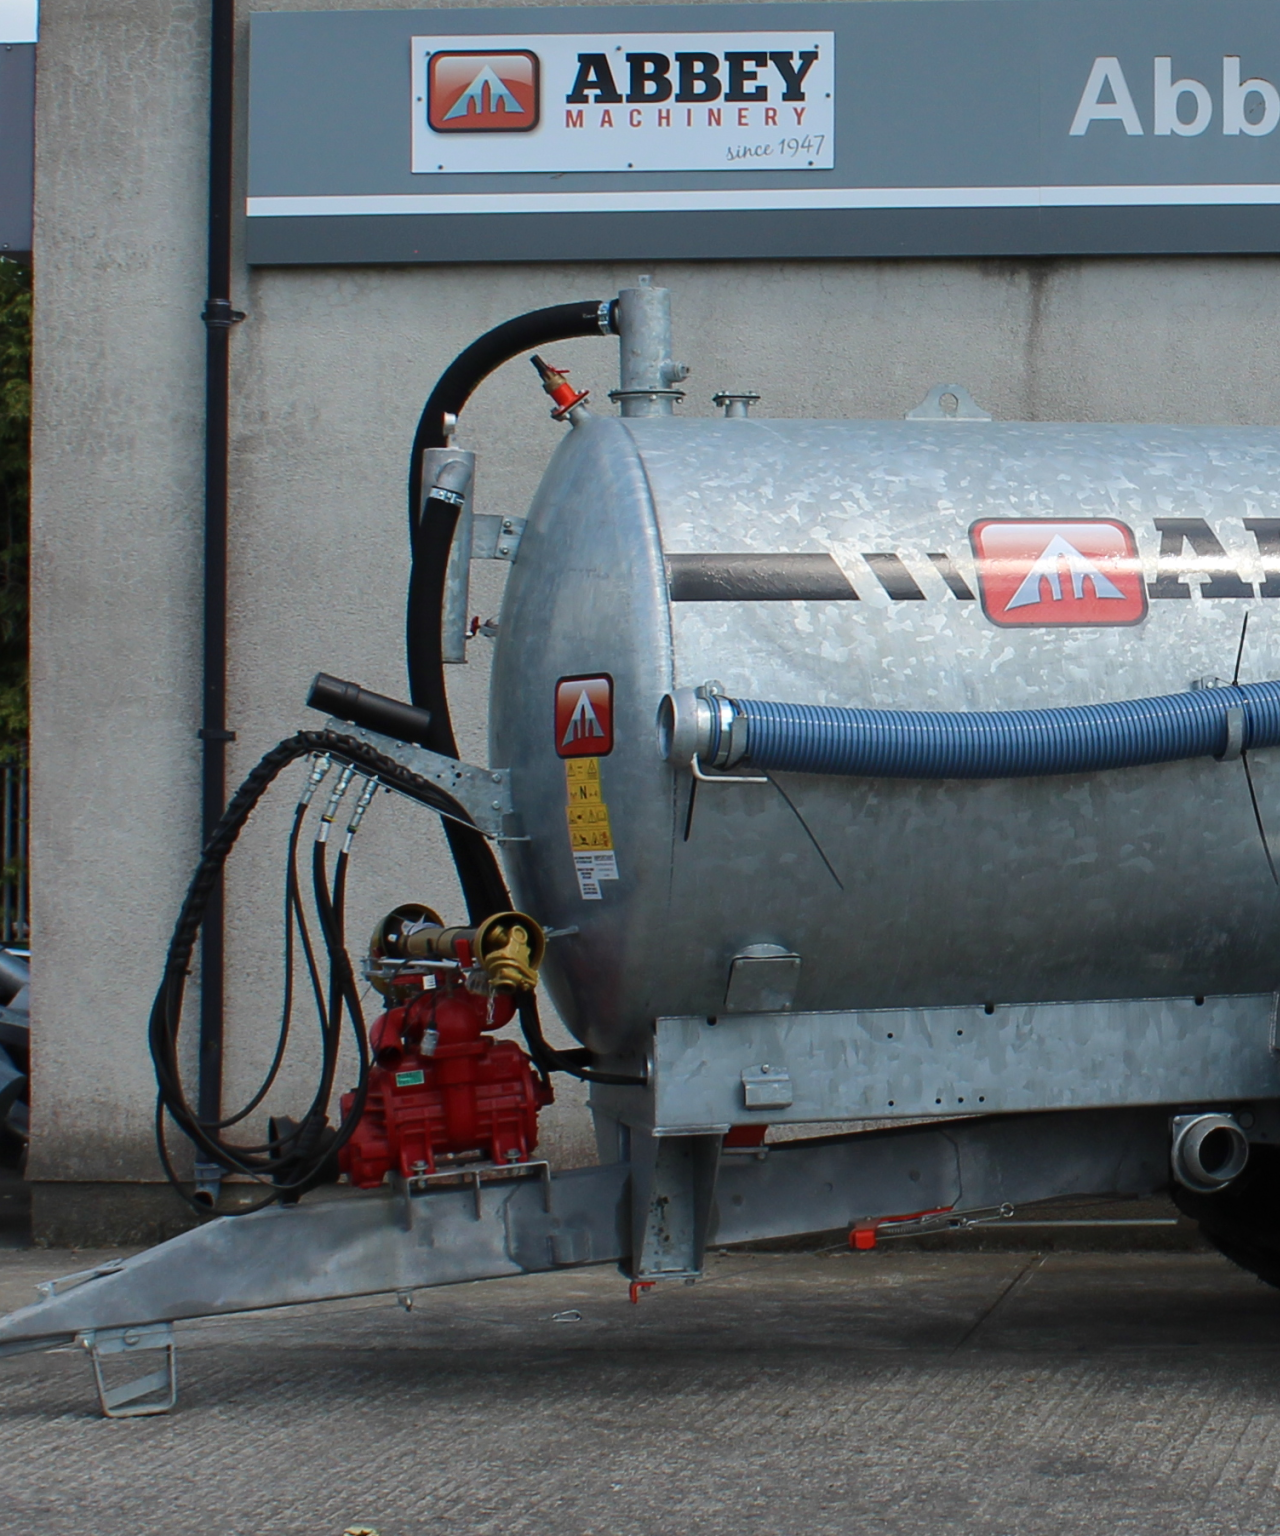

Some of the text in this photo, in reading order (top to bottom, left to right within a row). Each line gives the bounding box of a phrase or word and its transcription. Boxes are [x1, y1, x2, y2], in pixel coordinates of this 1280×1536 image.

[565, 51, 819, 104] ABBEY
[565, 107, 807, 129] MACHINERY
[726, 134, 826, 162] since 1947
